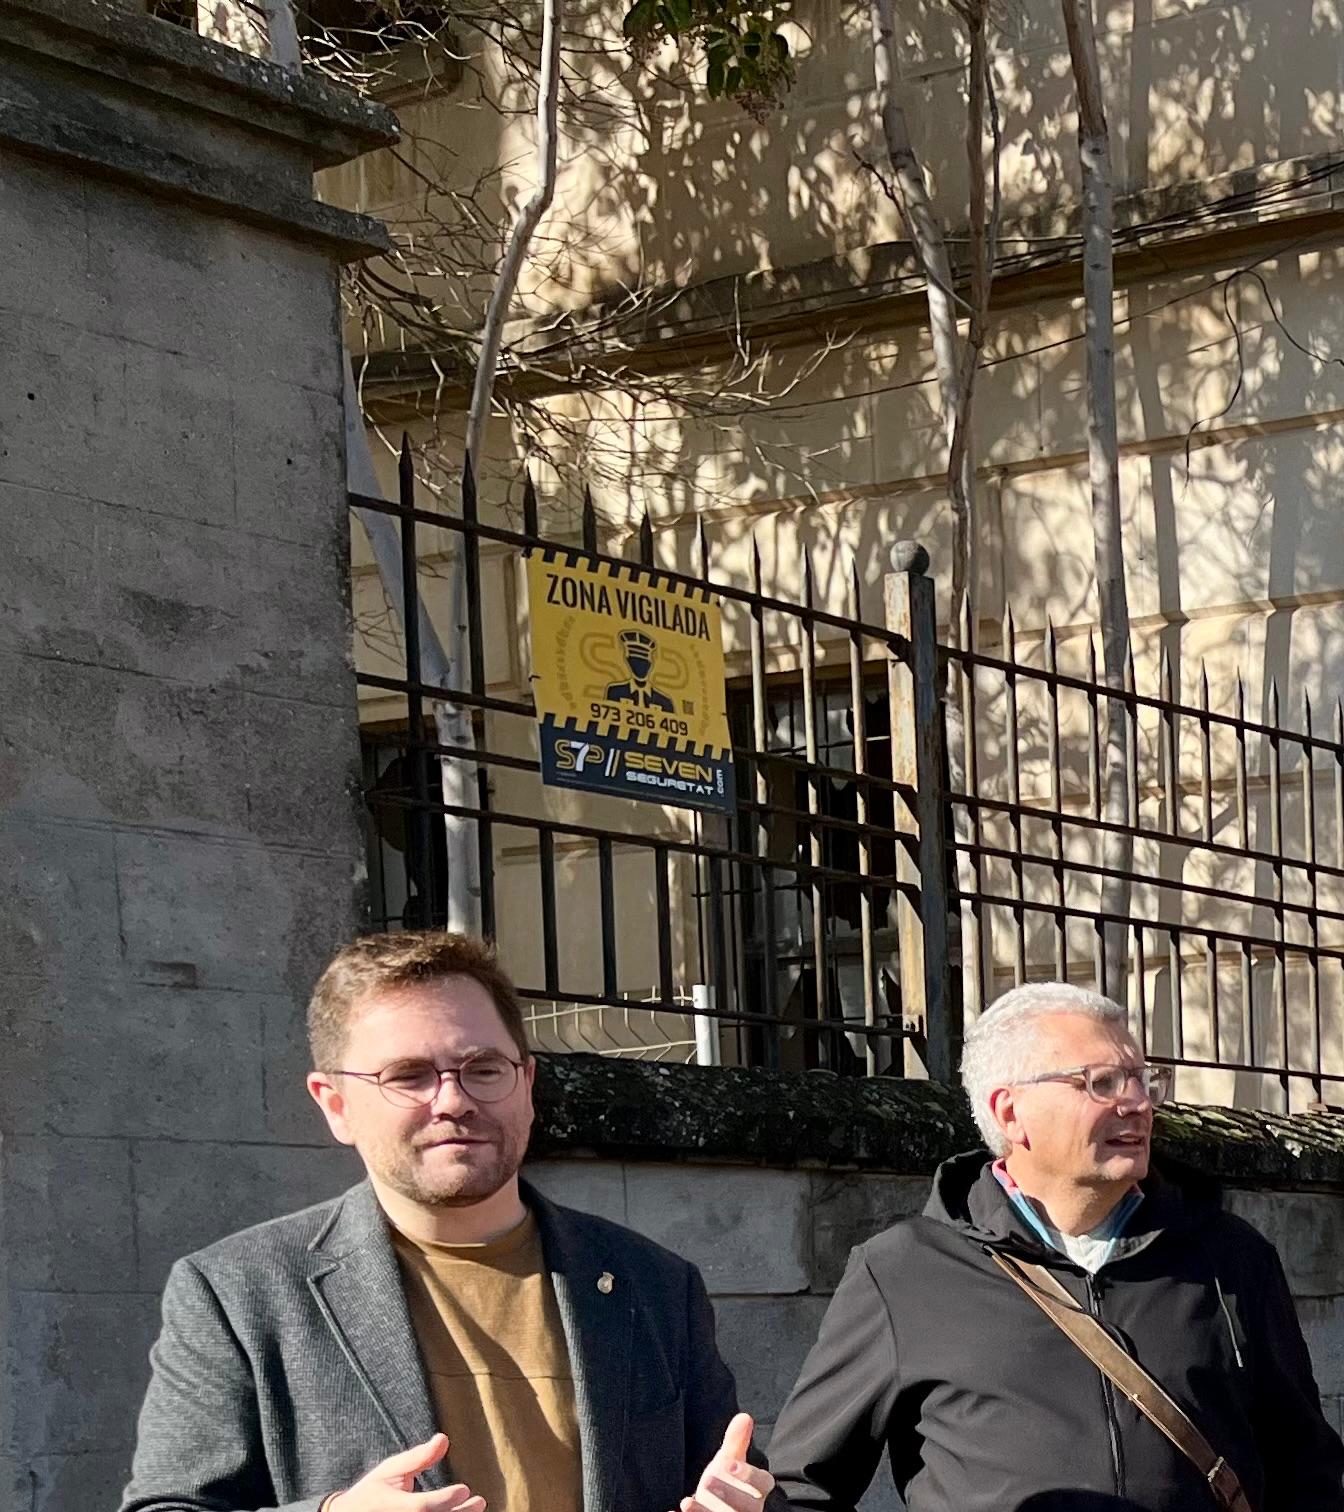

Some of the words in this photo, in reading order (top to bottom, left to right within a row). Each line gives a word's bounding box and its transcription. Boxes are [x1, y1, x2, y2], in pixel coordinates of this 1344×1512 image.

[546, 573, 612, 616] ZONA
[616, 588, 710, 642] VIGILADA
[590, 702, 621, 722] 973
[626, 709, 656, 729] 206
[660, 717, 688, 737] 409
[624, 751, 713, 783] SEVEN
[625, 770, 714, 796] SEGURETAT
